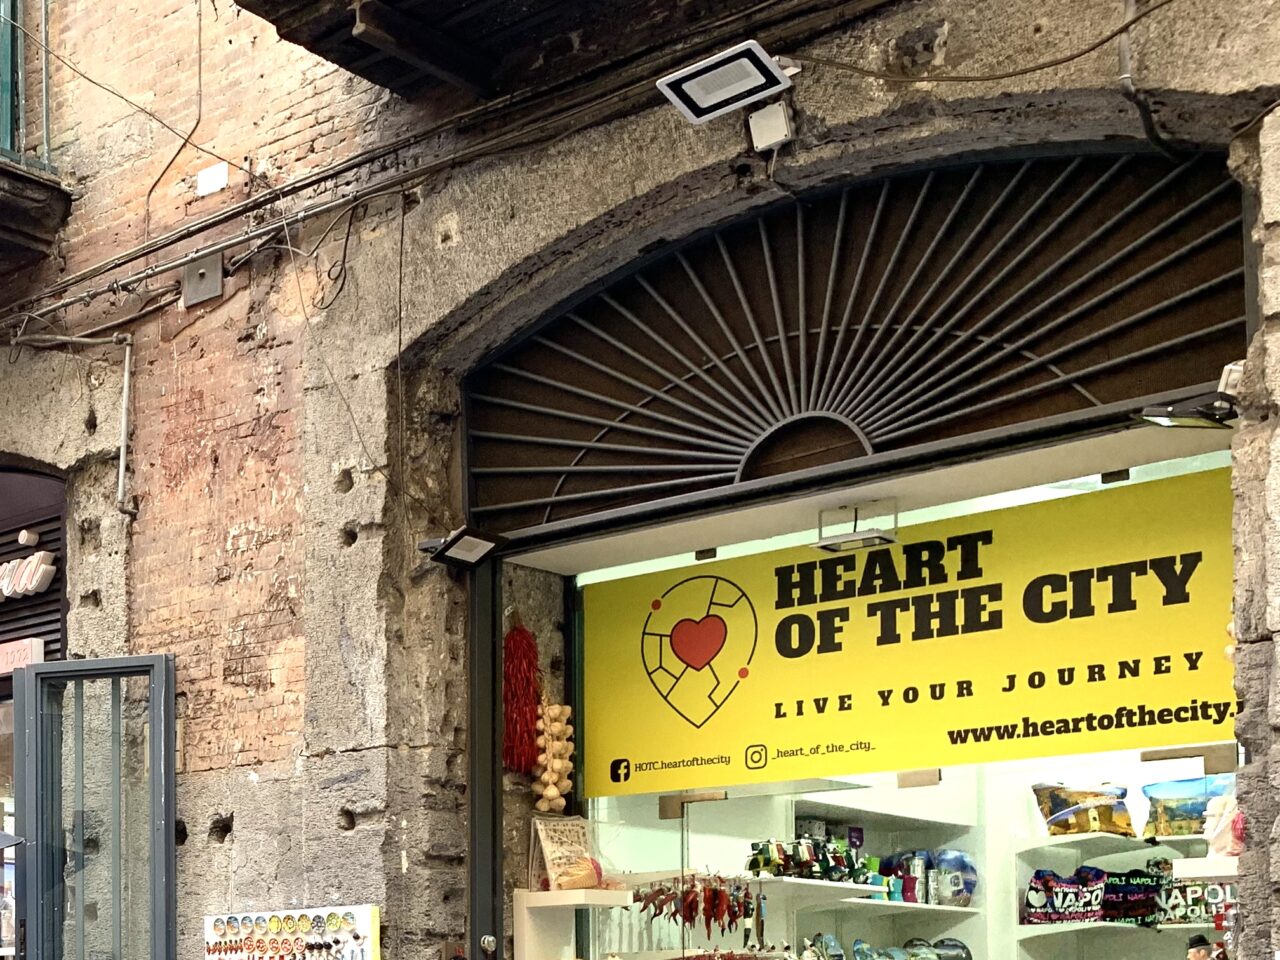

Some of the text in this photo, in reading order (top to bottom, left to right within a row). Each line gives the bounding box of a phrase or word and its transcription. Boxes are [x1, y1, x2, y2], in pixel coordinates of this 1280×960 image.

[775, 529, 993, 610] HEART
[775, 551, 1203, 659] OF THE CITY
[774, 650, 1206, 719] LIVE YOUR JOURNEY
